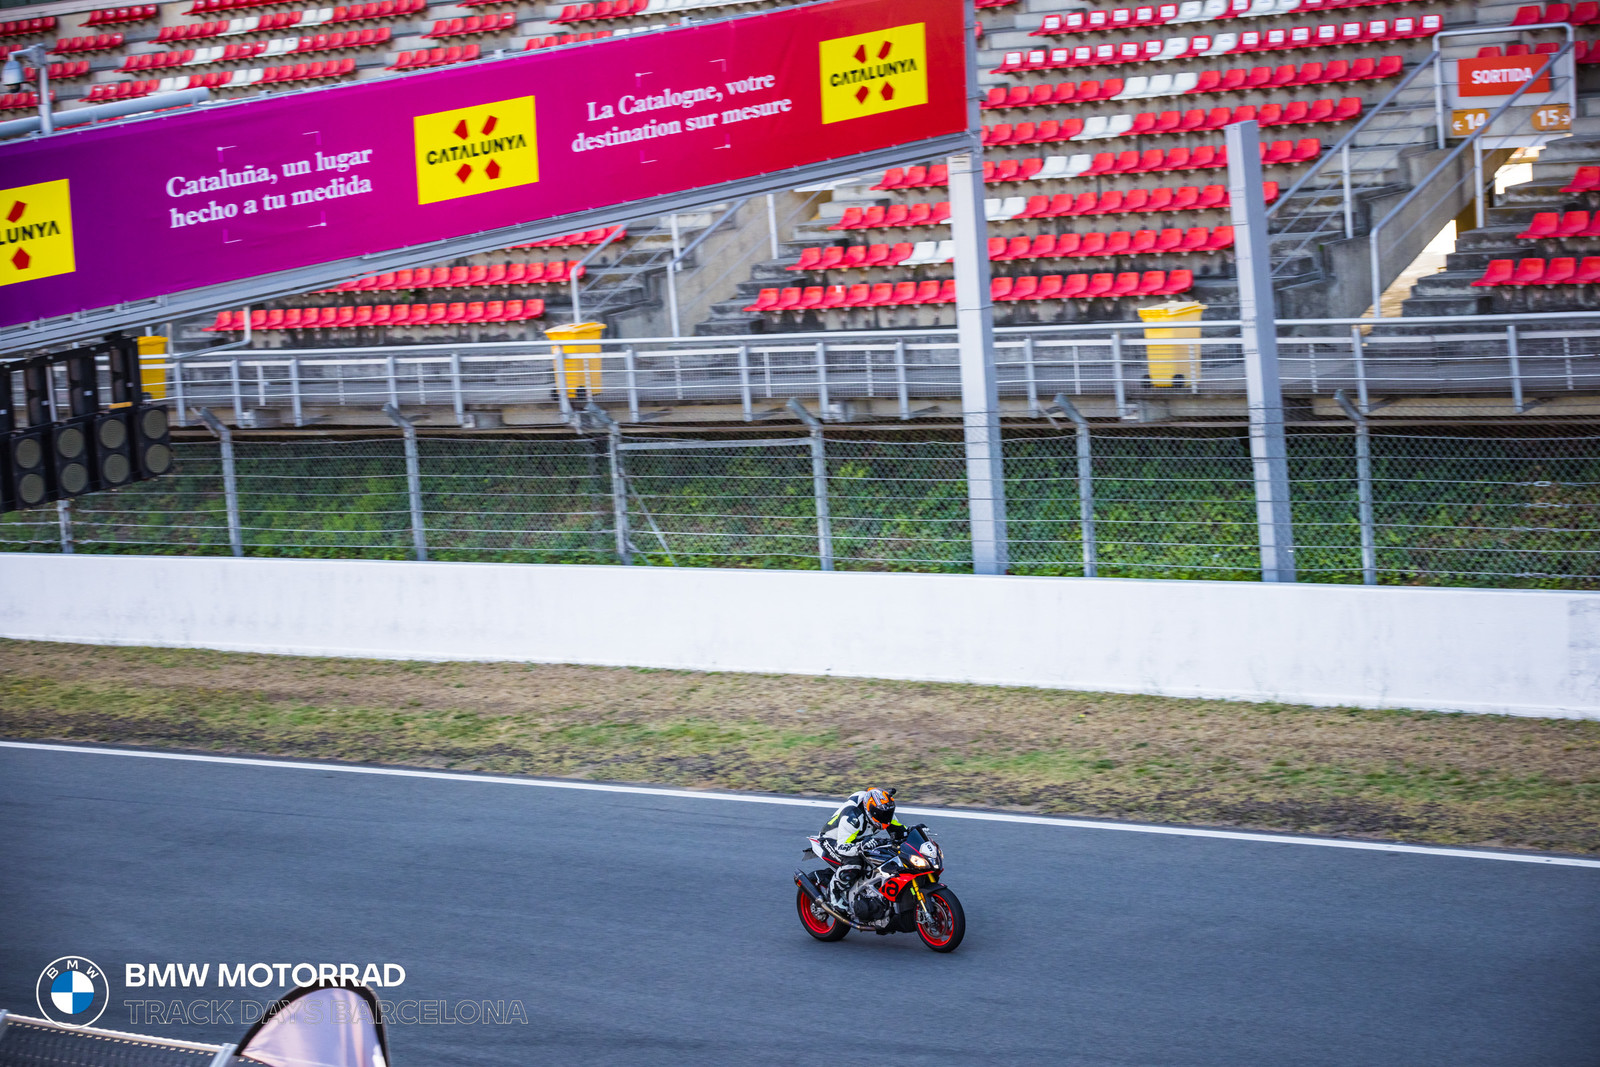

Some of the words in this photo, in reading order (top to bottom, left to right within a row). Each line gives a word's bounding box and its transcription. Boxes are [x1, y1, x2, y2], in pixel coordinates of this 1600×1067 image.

[829, 58, 918, 87] CATALUNYA
[1471, 67, 1534, 84] SORTIDA
[587, 102, 615, 121] La
[618, 88, 723, 115] Catalogne,
[725, 74, 775, 95] votre
[571, 119, 682, 152] destination
[685, 113, 719, 131] sur
[721, 98, 792, 124] mesure
[1464, 112, 1487, 130] 14
[1537, 109, 1560, 127] 15
[426, 134, 528, 165] CATALUNYA
[166, 164, 278, 197] Cataluña,
[281, 160, 312, 177] un
[315, 149, 373, 172] lugar
[169, 200, 238, 228] hecho
[243, 199, 258, 214] a
[262, 194, 287, 211] tu
[291, 175, 373, 206] medida
